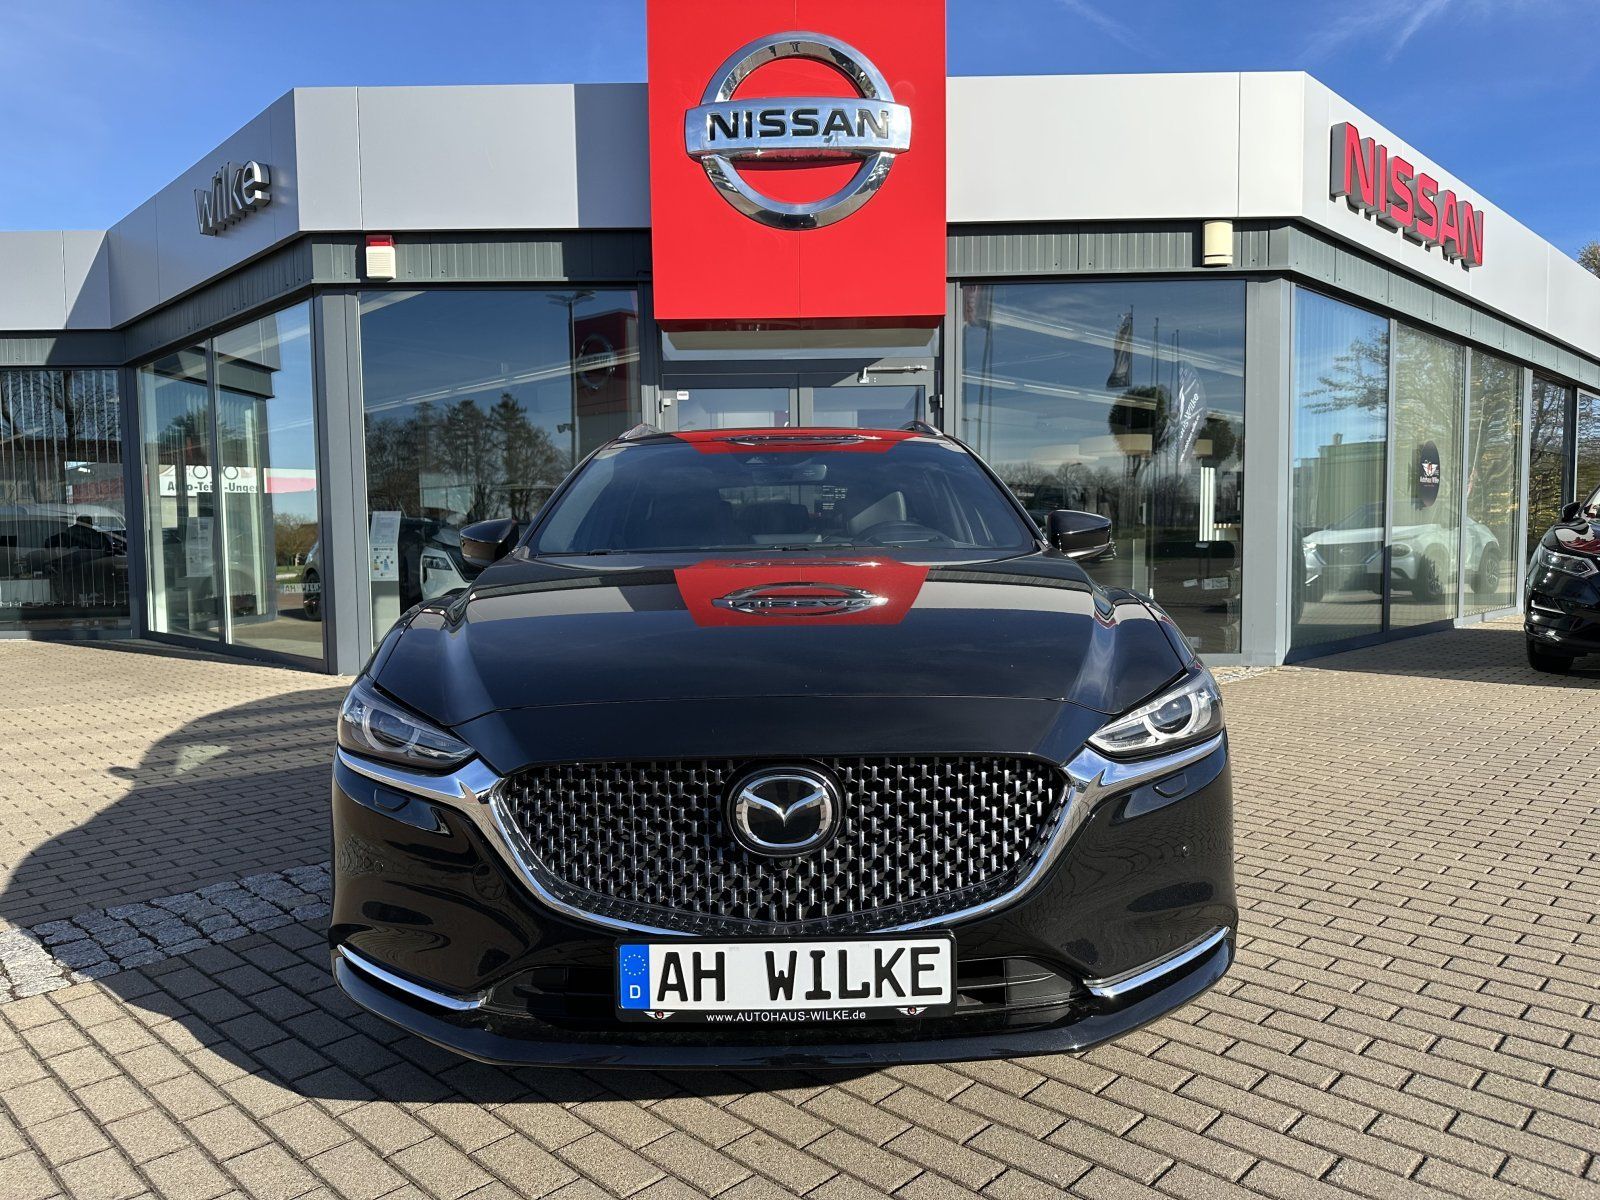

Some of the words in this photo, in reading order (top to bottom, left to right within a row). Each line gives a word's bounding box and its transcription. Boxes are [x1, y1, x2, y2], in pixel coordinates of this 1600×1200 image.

[706, 108, 888, 141] NISSAN
[1334, 121, 1483, 267] NISSAN
[657, 951, 725, 1002] AH
[765, 946, 943, 1001] WILKE
[629, 985, 641, 999] D
[706, 1010, 866, 1022] www.AUTOHAUS-WILKE.de
